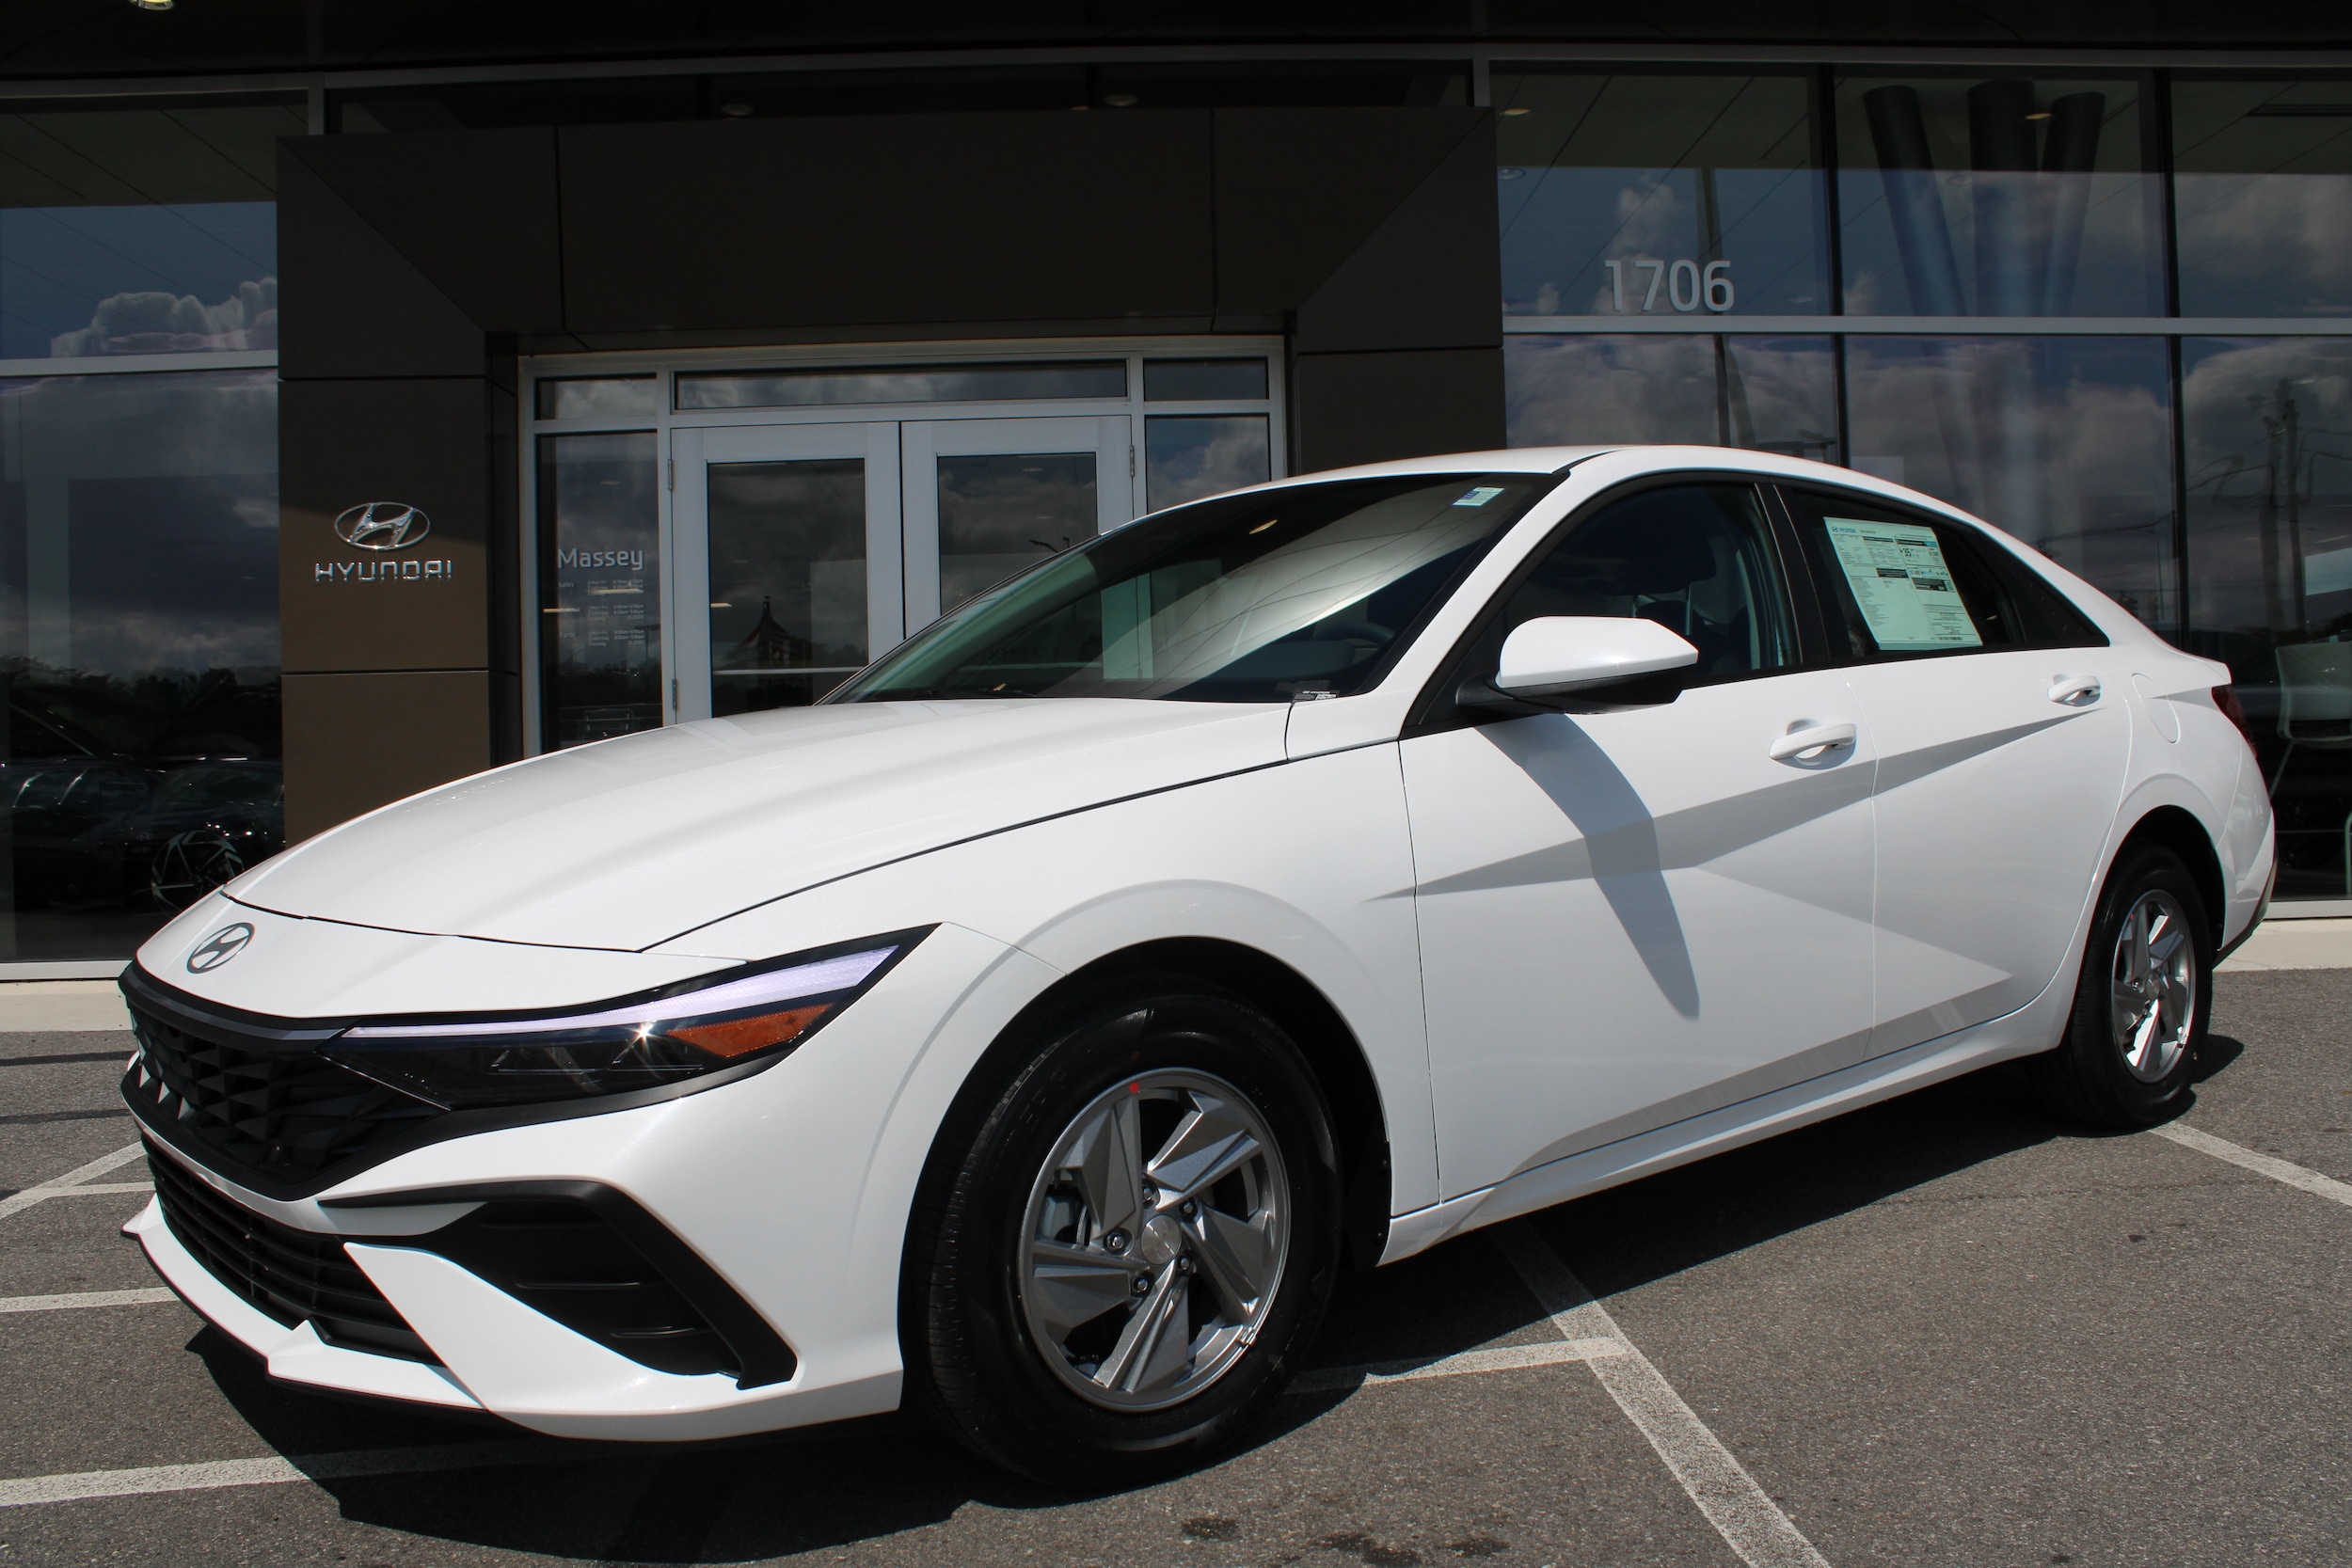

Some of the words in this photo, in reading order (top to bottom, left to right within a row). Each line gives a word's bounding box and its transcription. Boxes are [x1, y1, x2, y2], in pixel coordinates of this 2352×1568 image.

[1604, 259, 1735, 312] 1706
[557, 547, 644, 571] Massey
[315, 560, 453, 583] HYUNDAI
